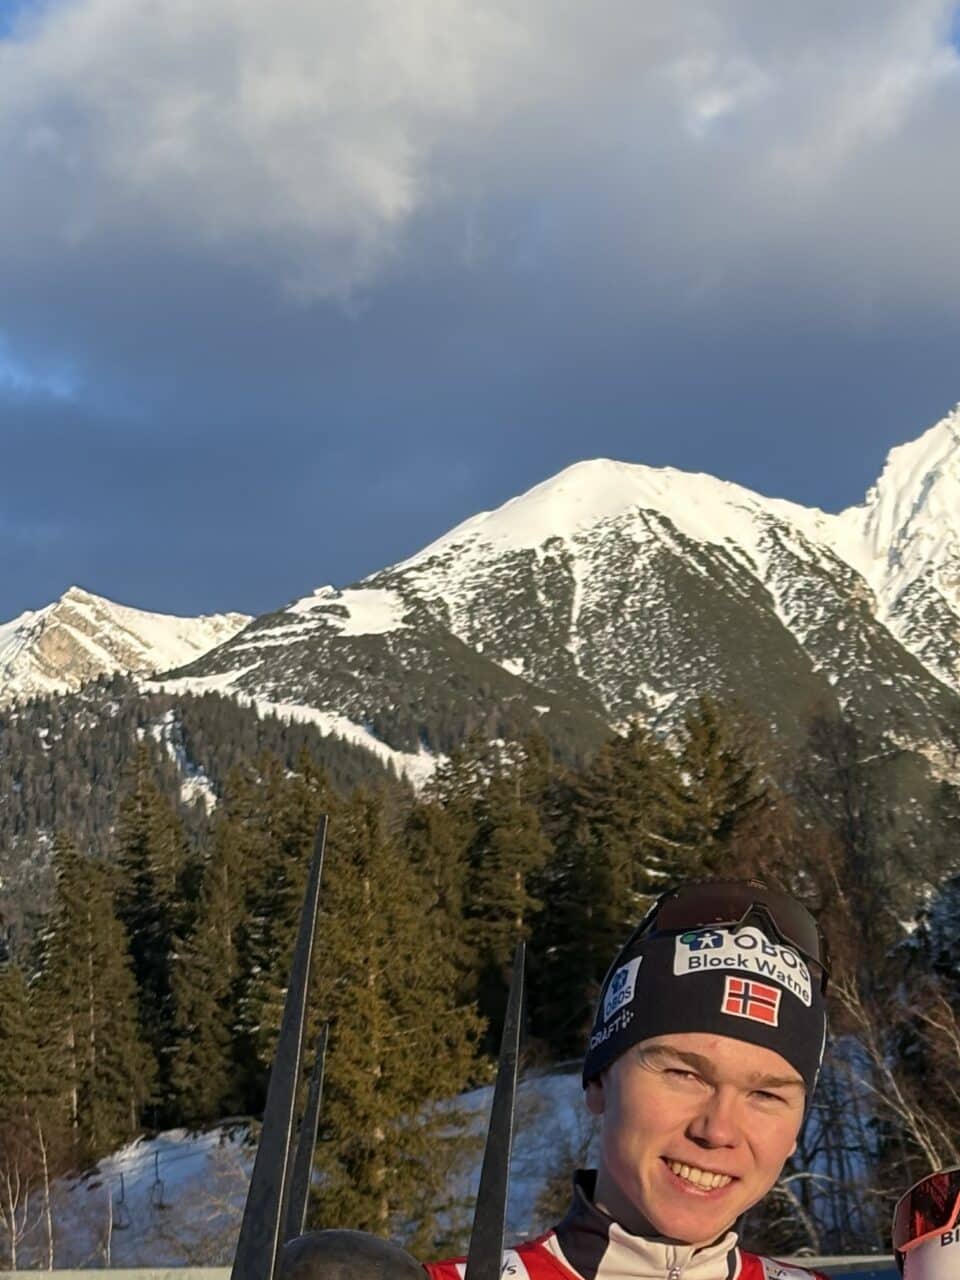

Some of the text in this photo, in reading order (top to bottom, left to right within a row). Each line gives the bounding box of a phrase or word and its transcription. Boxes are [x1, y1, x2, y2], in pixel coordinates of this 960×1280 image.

[688, 953, 810, 1001] Block Watne
[734, 934, 809, 981] OBOS
